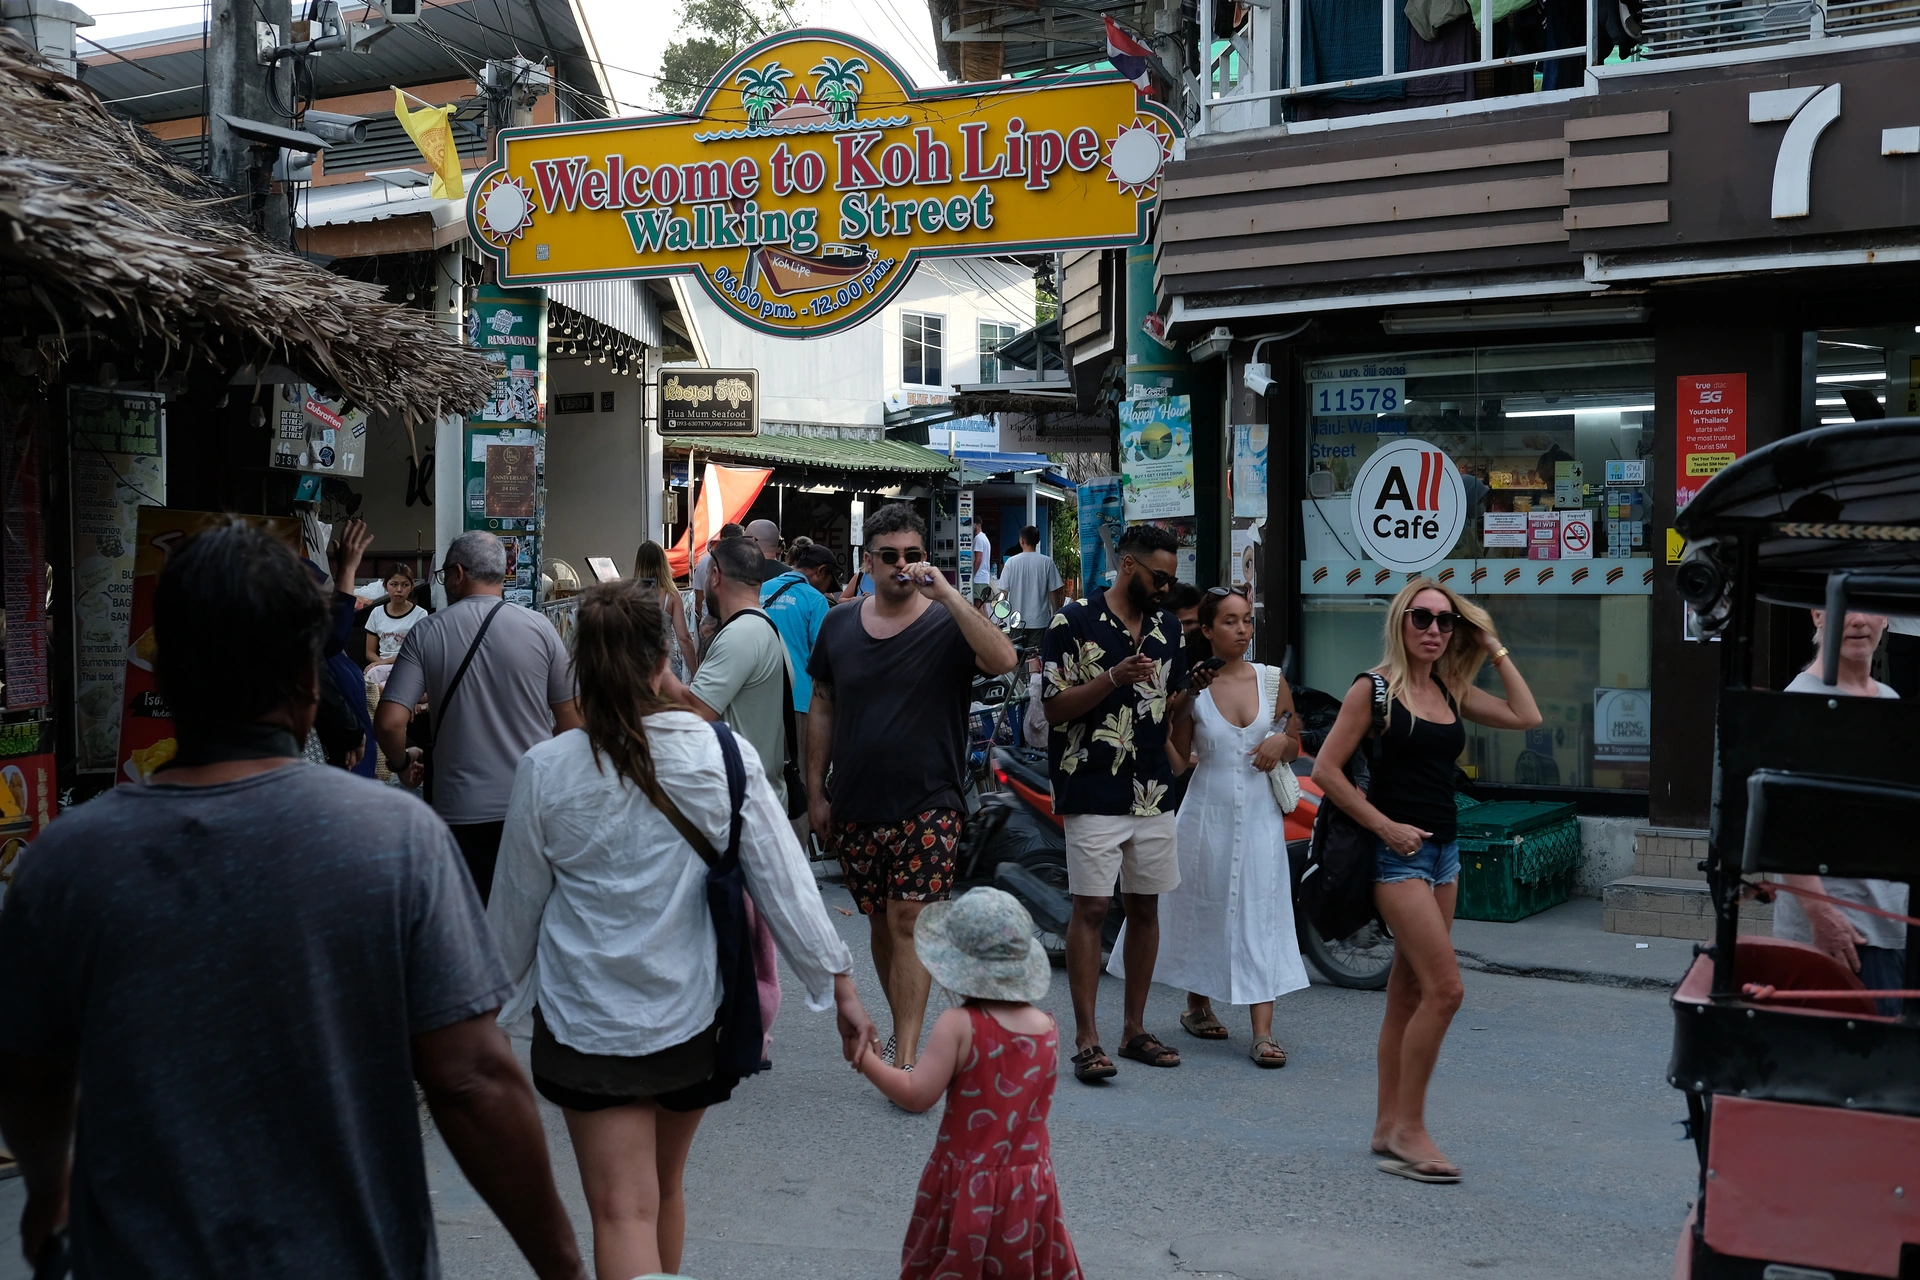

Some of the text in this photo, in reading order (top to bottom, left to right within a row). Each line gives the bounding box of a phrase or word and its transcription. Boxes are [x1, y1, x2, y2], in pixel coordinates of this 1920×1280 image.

[530, 116, 1101, 214] Welcome to Koh Lipe
[621, 184, 996, 253] Walking Street
[771, 256, 812, 286] Koh Lipe
[714, 265, 762, 310] 06.00
[809, 283, 861, 318] 12.00
[1695, 382, 1712, 390] true
[1319, 387, 1398, 412] 11578
[1699, 390, 1723, 404] 5G
[306, 401, 342, 429] Clubratten
[667, 409, 747, 418] Hua Mum Seafood
[1121, 403, 1188, 425] Happy Hour
[1688, 408, 1704, 416] Your
[1721, 407, 1734, 415] trip
[1693, 417, 1700, 425] in
[1347, 418, 1408, 437] Walking
[1311, 443, 1357, 458] Street
[1694, 443, 1715, 451] Tourist
[342, 453, 355, 472] 17
[1374, 452, 1443, 511] All
[1373, 513, 1440, 540] Café
[81, 672, 114, 681] Thai food
[1611, 729, 1647, 738] THONG
[1613, 721, 1644, 730] HONG
